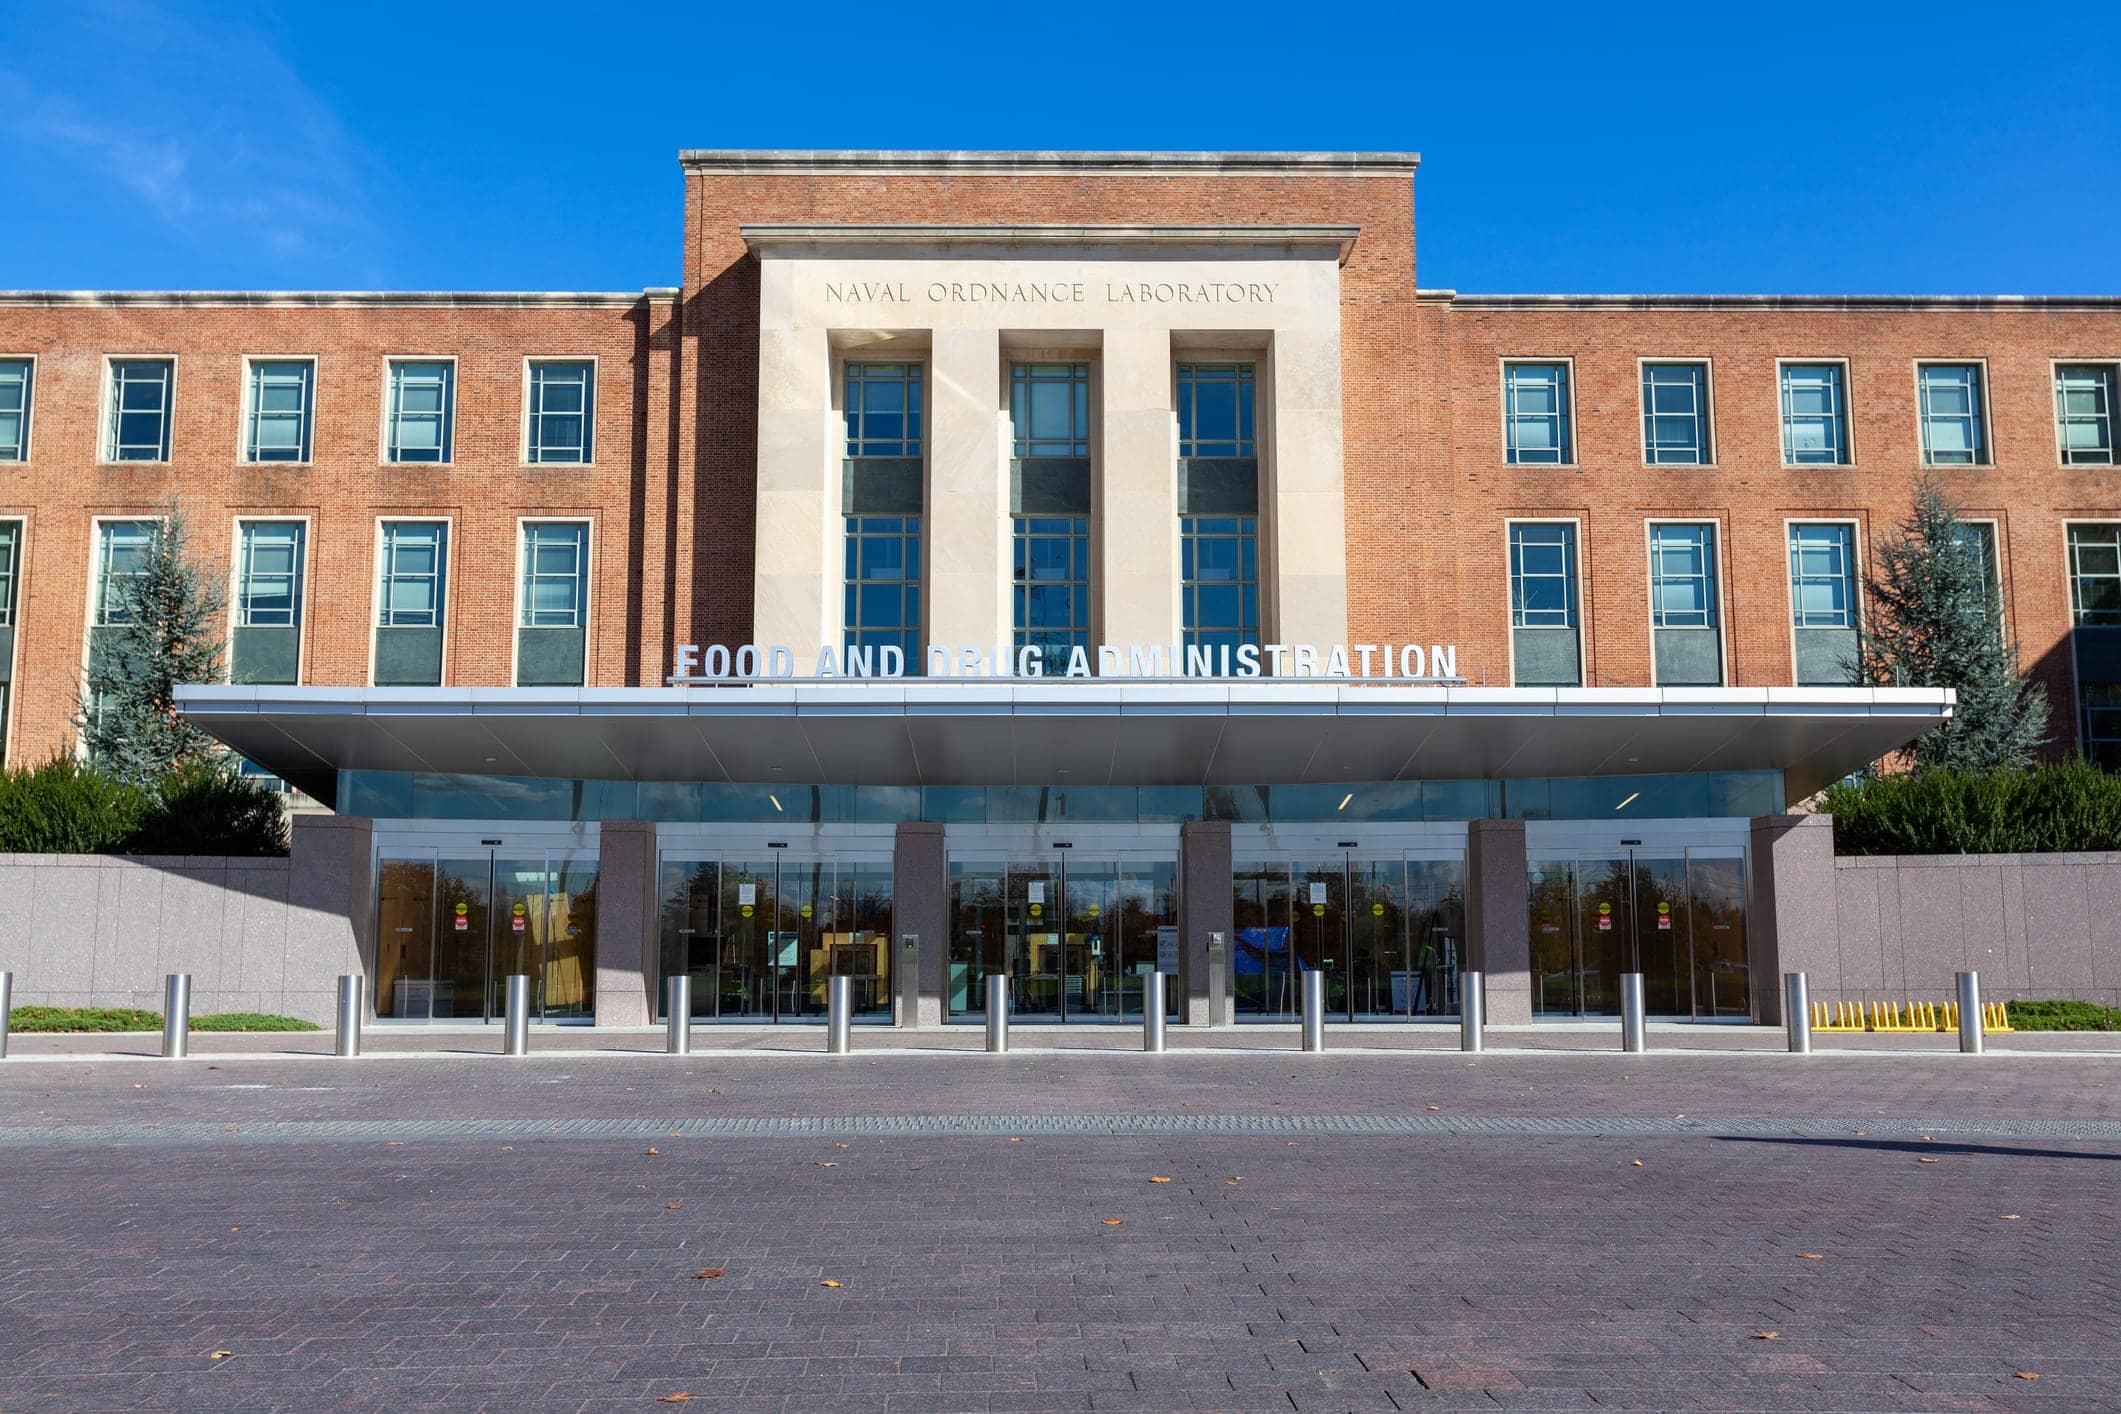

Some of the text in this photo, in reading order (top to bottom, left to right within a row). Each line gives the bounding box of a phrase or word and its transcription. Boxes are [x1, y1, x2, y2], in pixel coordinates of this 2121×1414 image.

[825, 282, 1279, 303] NAVAL ORDNANCE LABORATORY
[676, 644, 1458, 679] FOOD AND DRUG ADMINISTRATION
